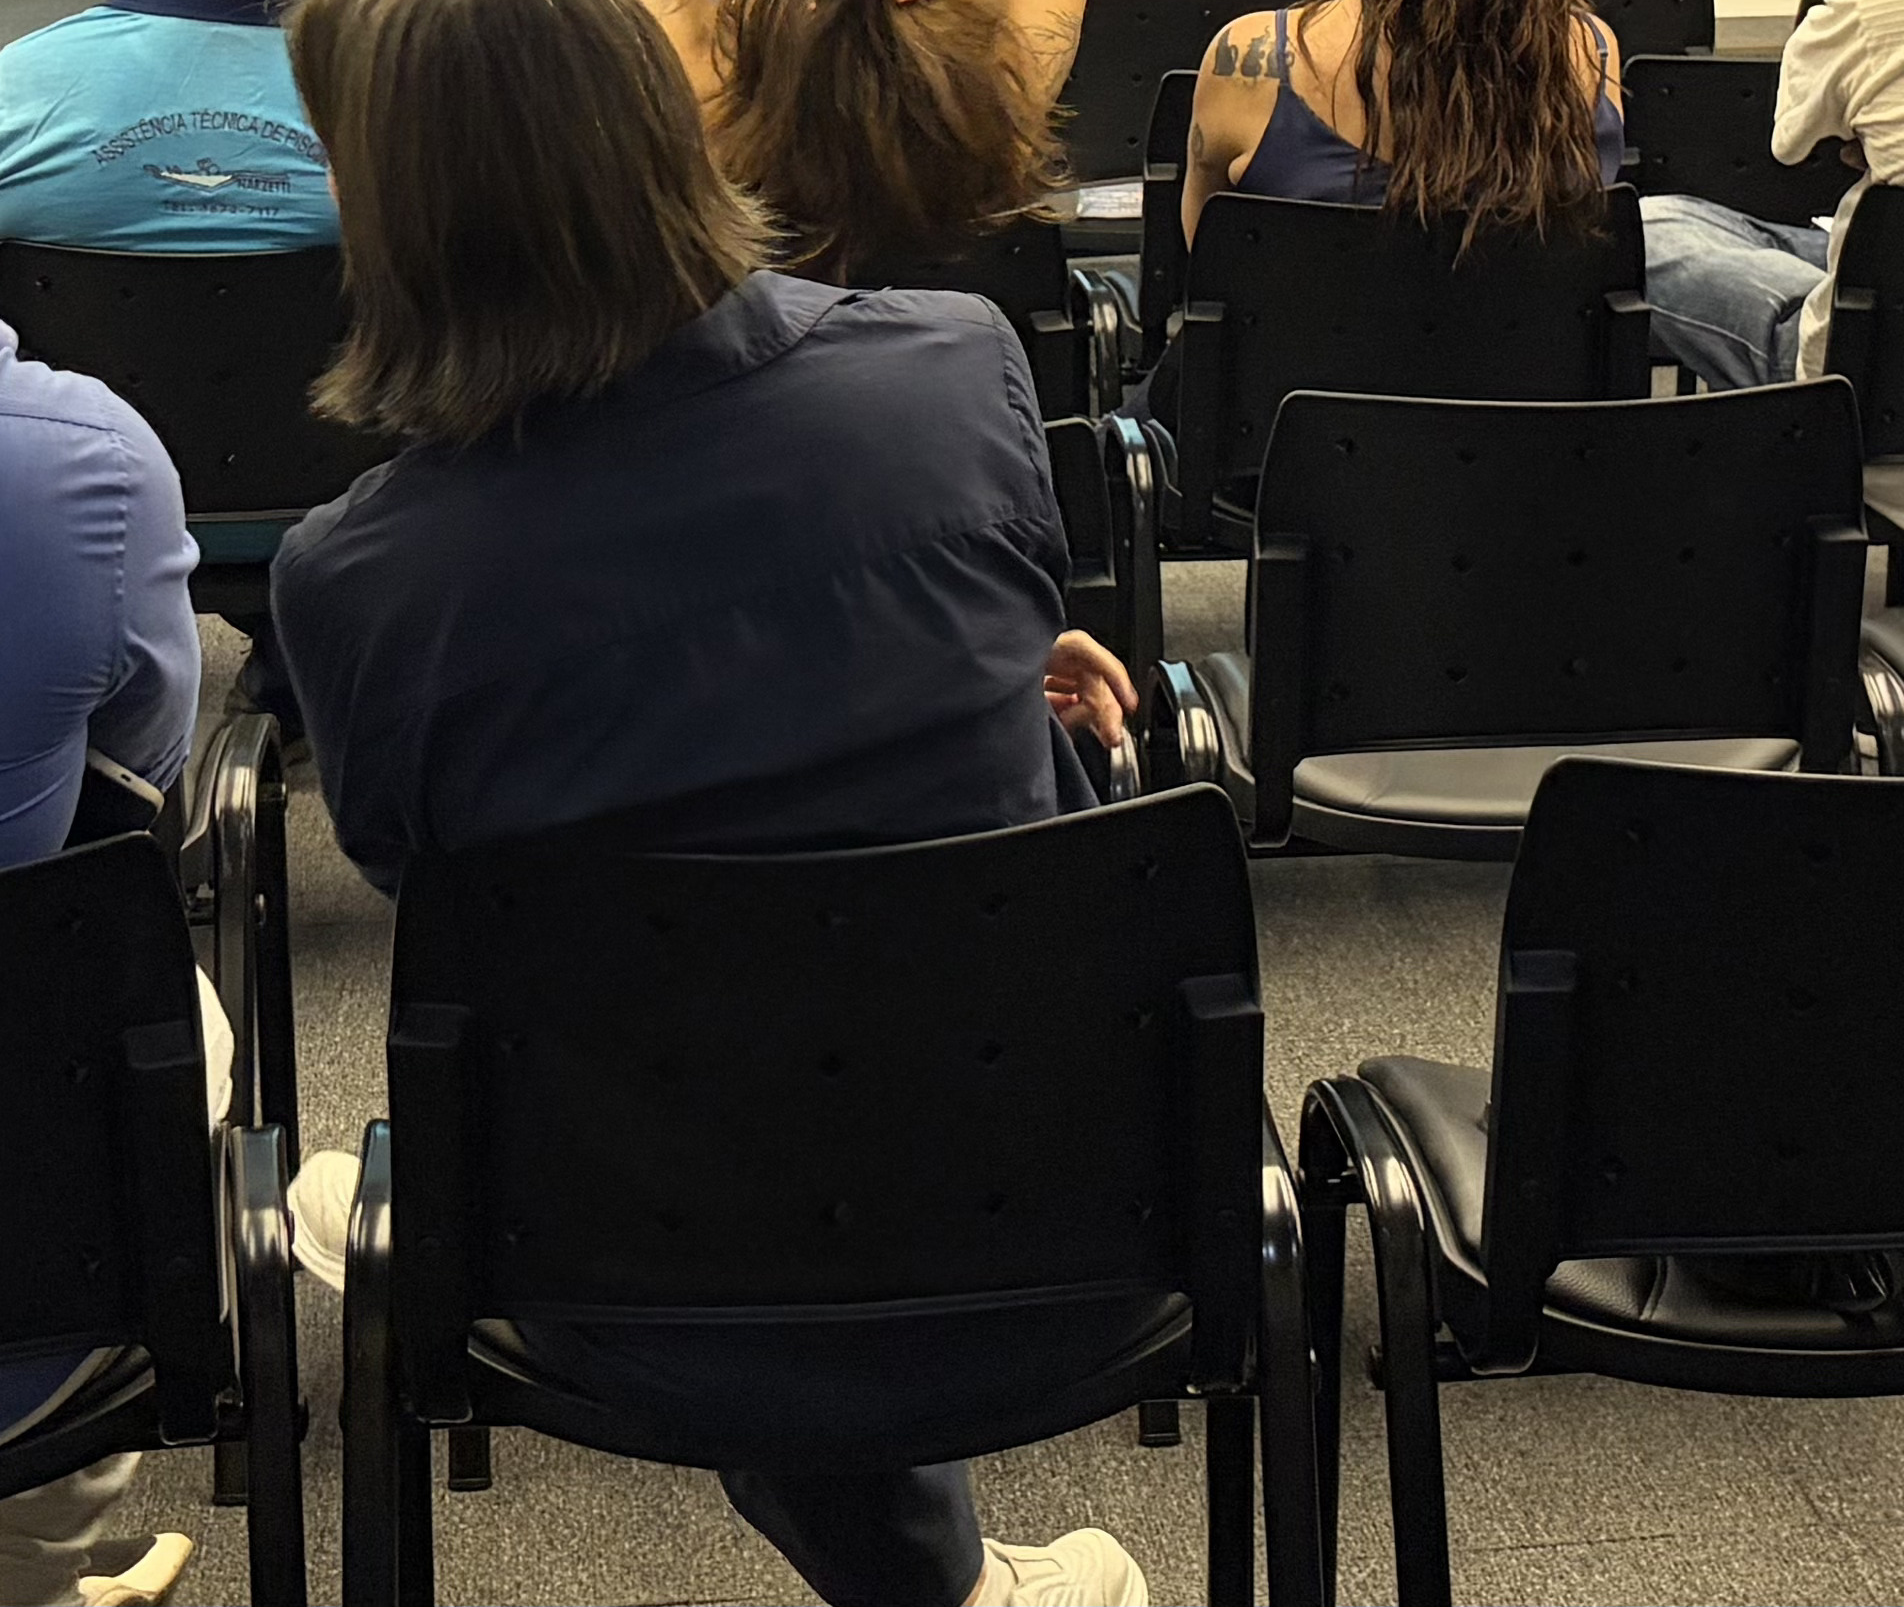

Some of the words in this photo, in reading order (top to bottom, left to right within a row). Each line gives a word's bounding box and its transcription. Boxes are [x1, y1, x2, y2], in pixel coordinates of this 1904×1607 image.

[91, 112, 187, 165] ASSISTÊNCIA
[192, 109, 258, 135] TÉCNICA
[261, 121, 284, 142] DE
